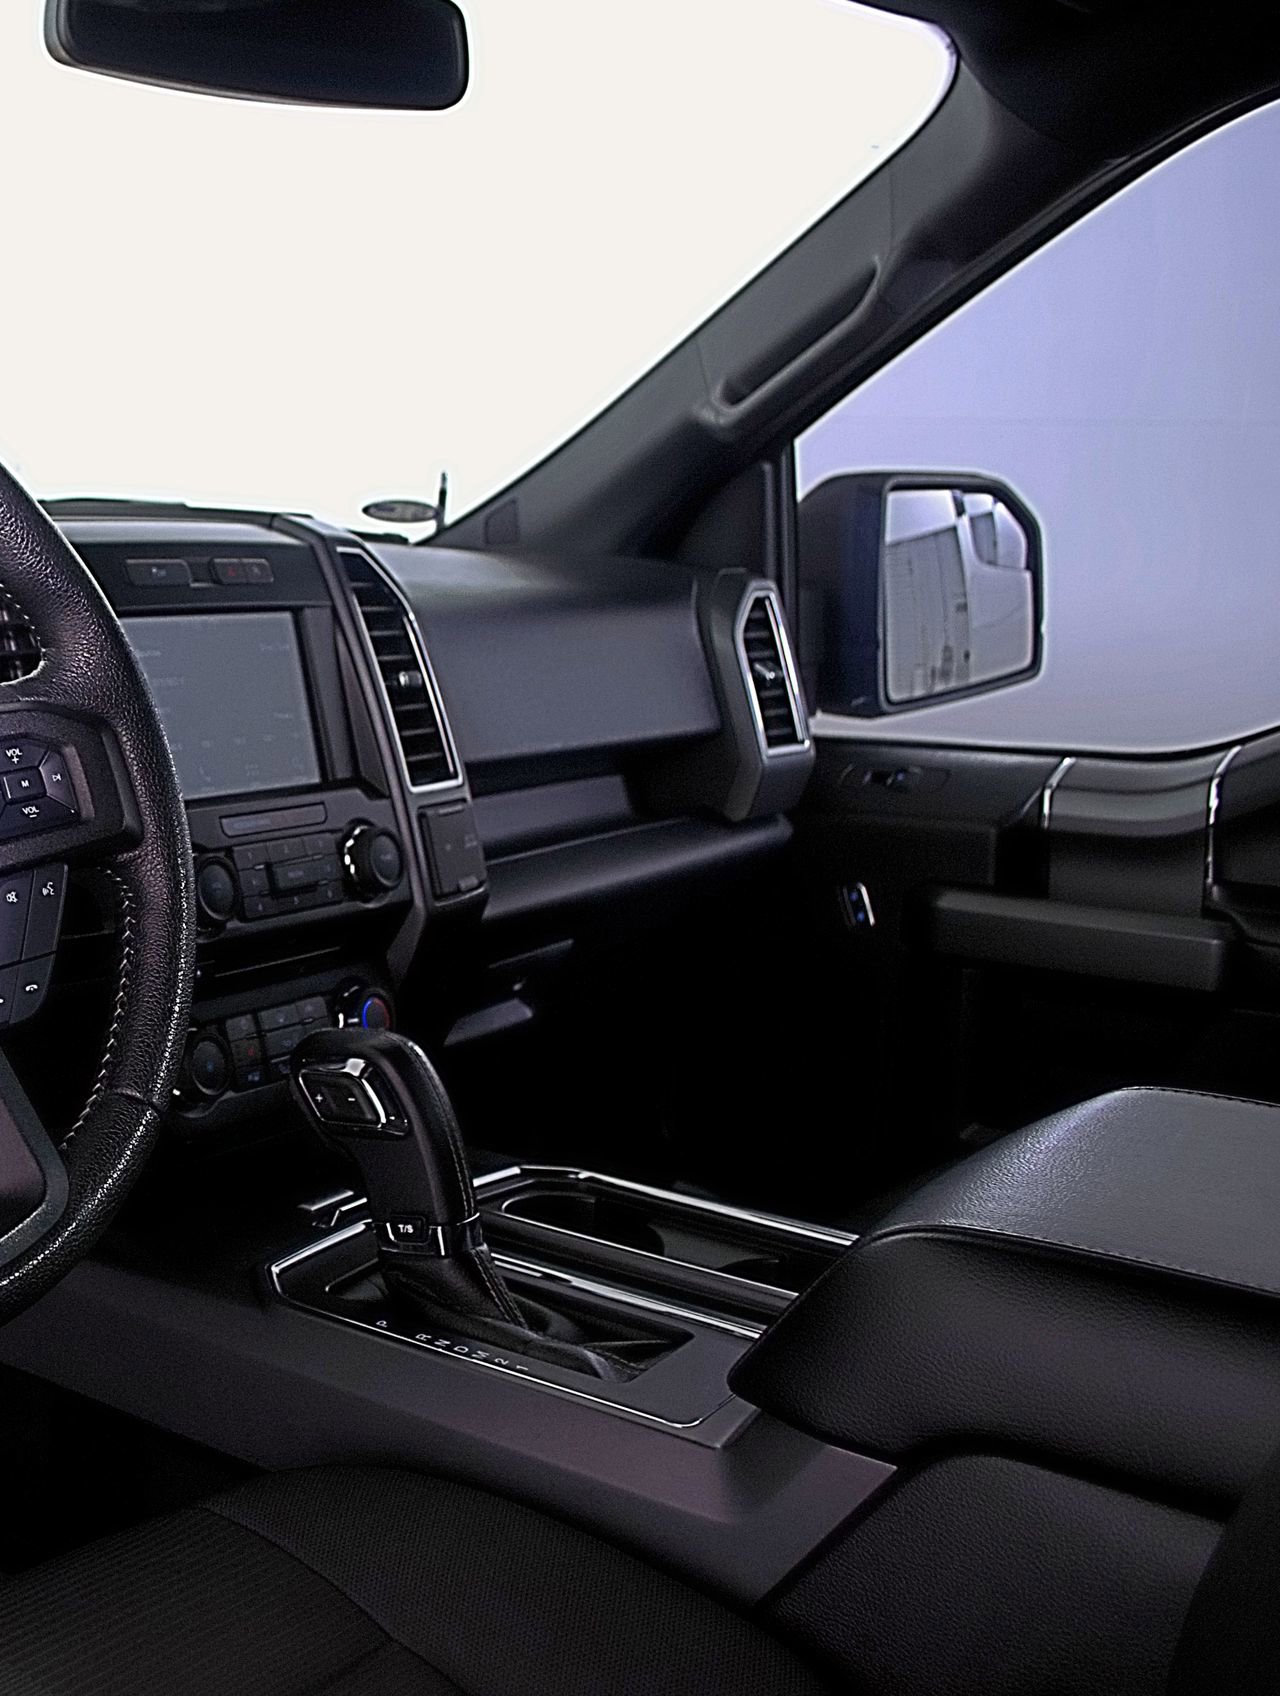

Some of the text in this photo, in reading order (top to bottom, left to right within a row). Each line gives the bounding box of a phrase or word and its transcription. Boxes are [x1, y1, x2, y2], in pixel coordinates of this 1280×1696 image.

[5, 747, 23, 757] VOL
[22, 805, 39, 815] VOL
[415, 1332, 432, 1341] R
[434, 1338, 451, 1347] N
[453, 1345, 469, 1354] D
